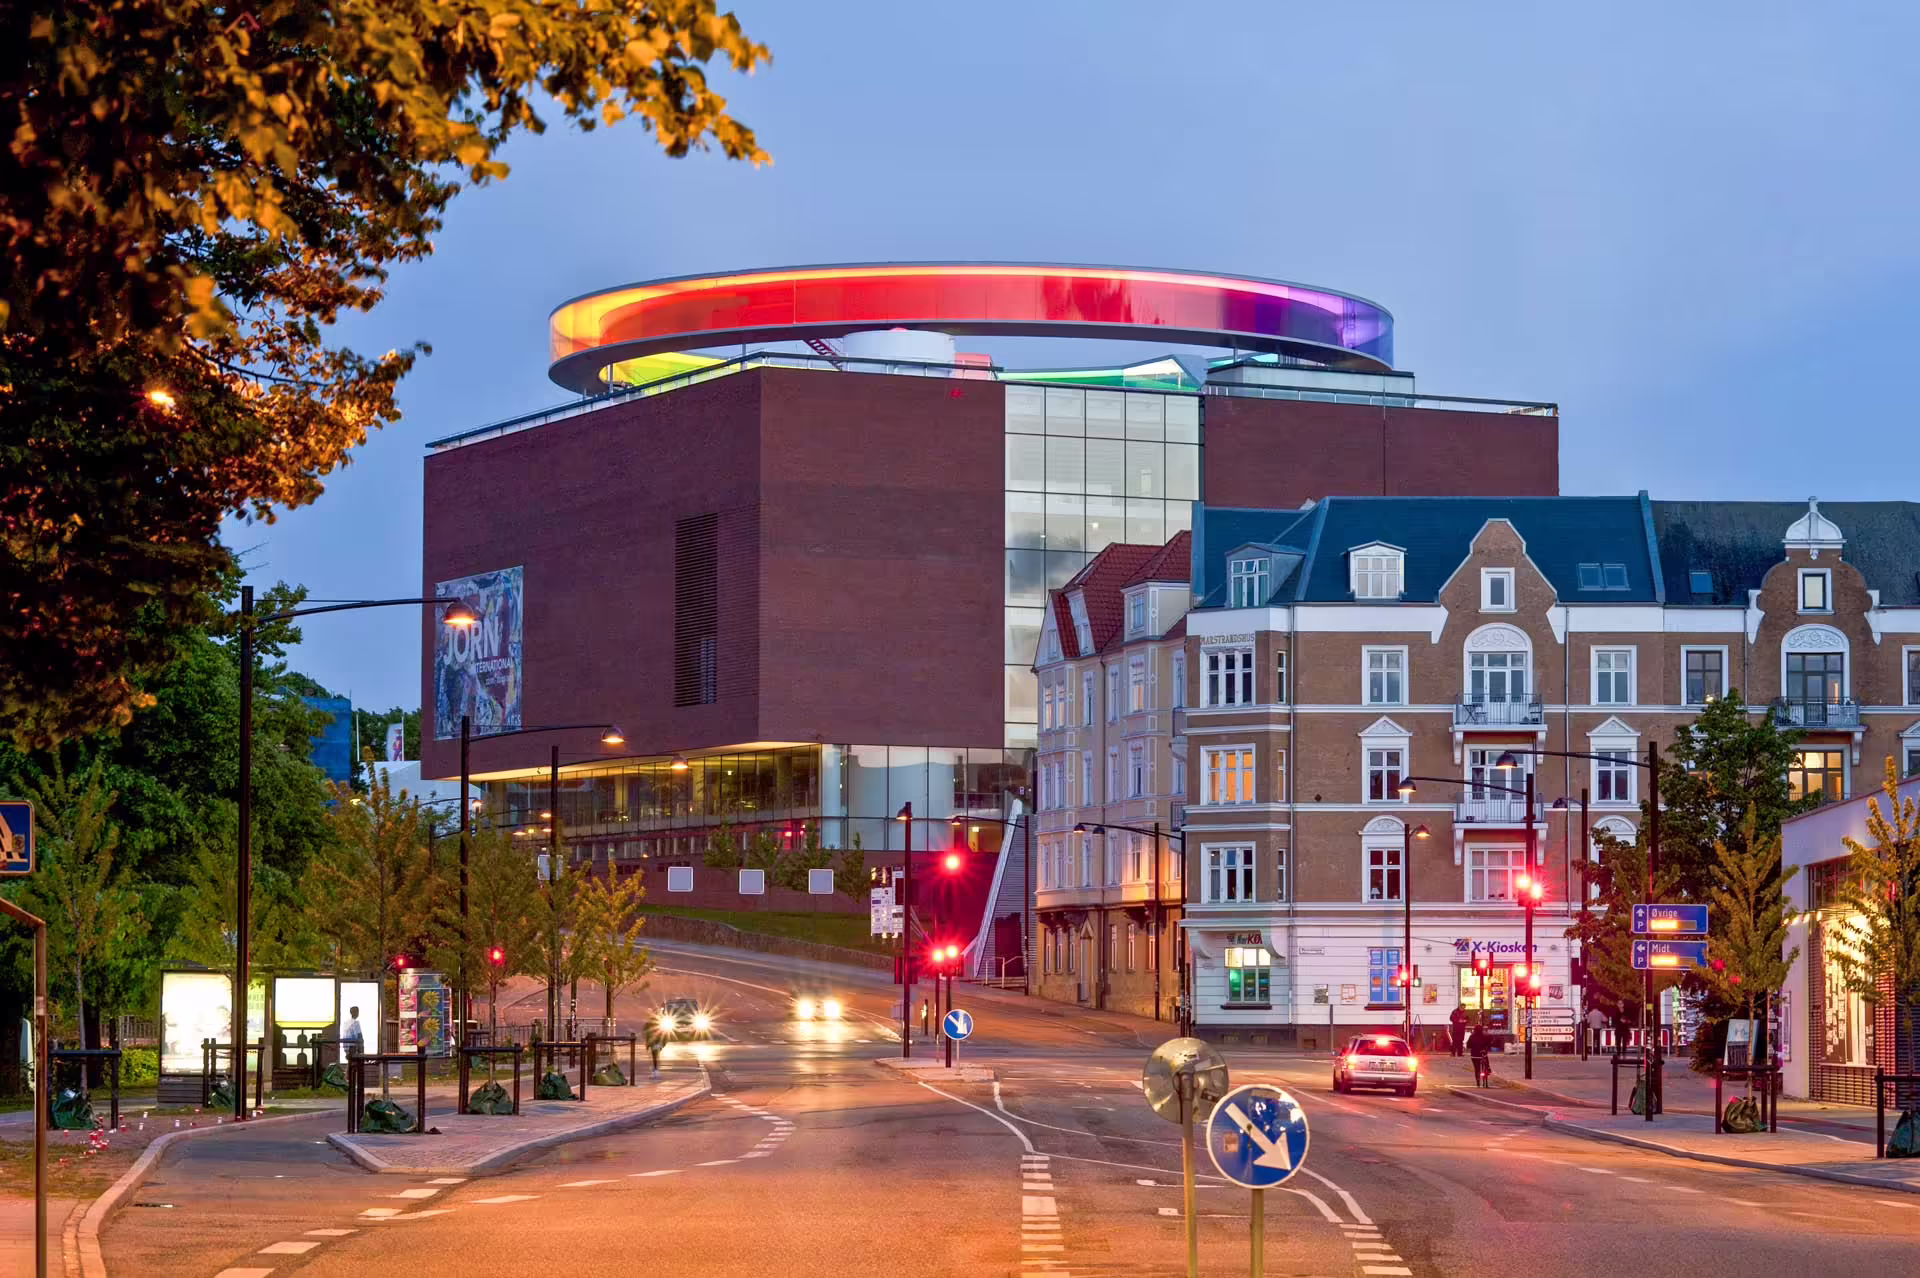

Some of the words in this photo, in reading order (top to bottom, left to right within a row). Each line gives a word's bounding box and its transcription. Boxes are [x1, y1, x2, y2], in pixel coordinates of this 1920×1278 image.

[443, 616, 499, 665] JORN
[470, 657, 513, 674] TERNATIONAL
[1651, 908, 1678, 919] Øvrige
[1637, 921, 1644, 929] P
[1651, 943, 1670, 953] Midt
[1637, 957, 1644, 965] P
